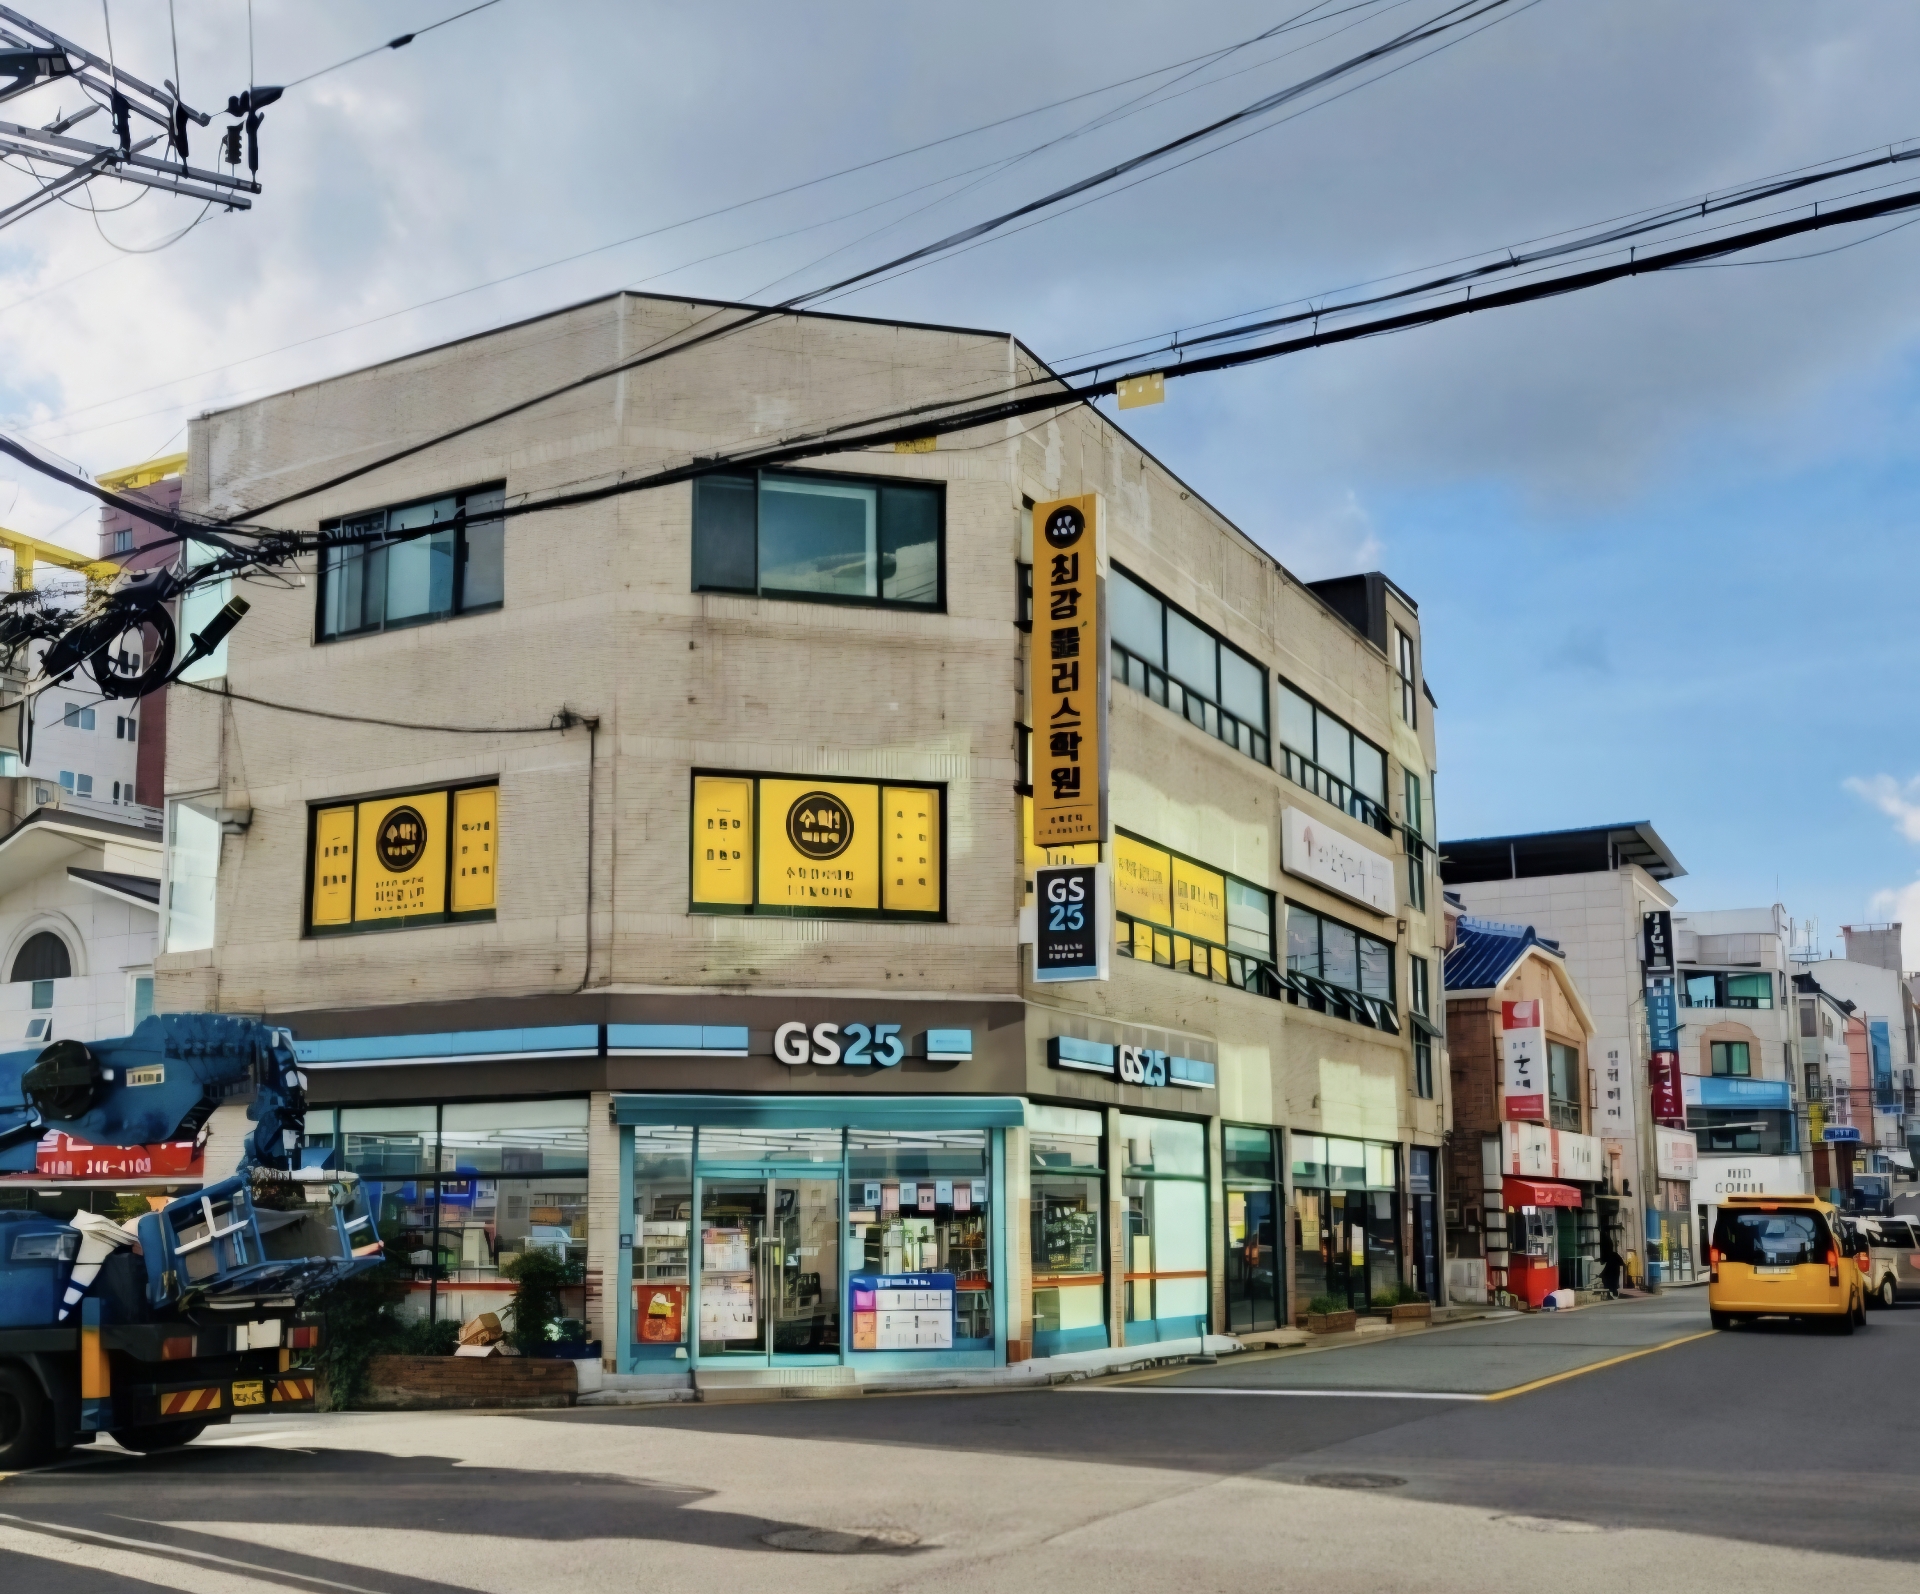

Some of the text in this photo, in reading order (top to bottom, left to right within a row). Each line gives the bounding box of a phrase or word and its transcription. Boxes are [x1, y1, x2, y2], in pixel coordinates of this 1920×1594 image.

[1048, 877, 1085, 903] GS
[1049, 903, 1084, 930] 25
[774, 1021, 905, 1067] GS25
[1119, 1044, 1166, 1087] GS25
